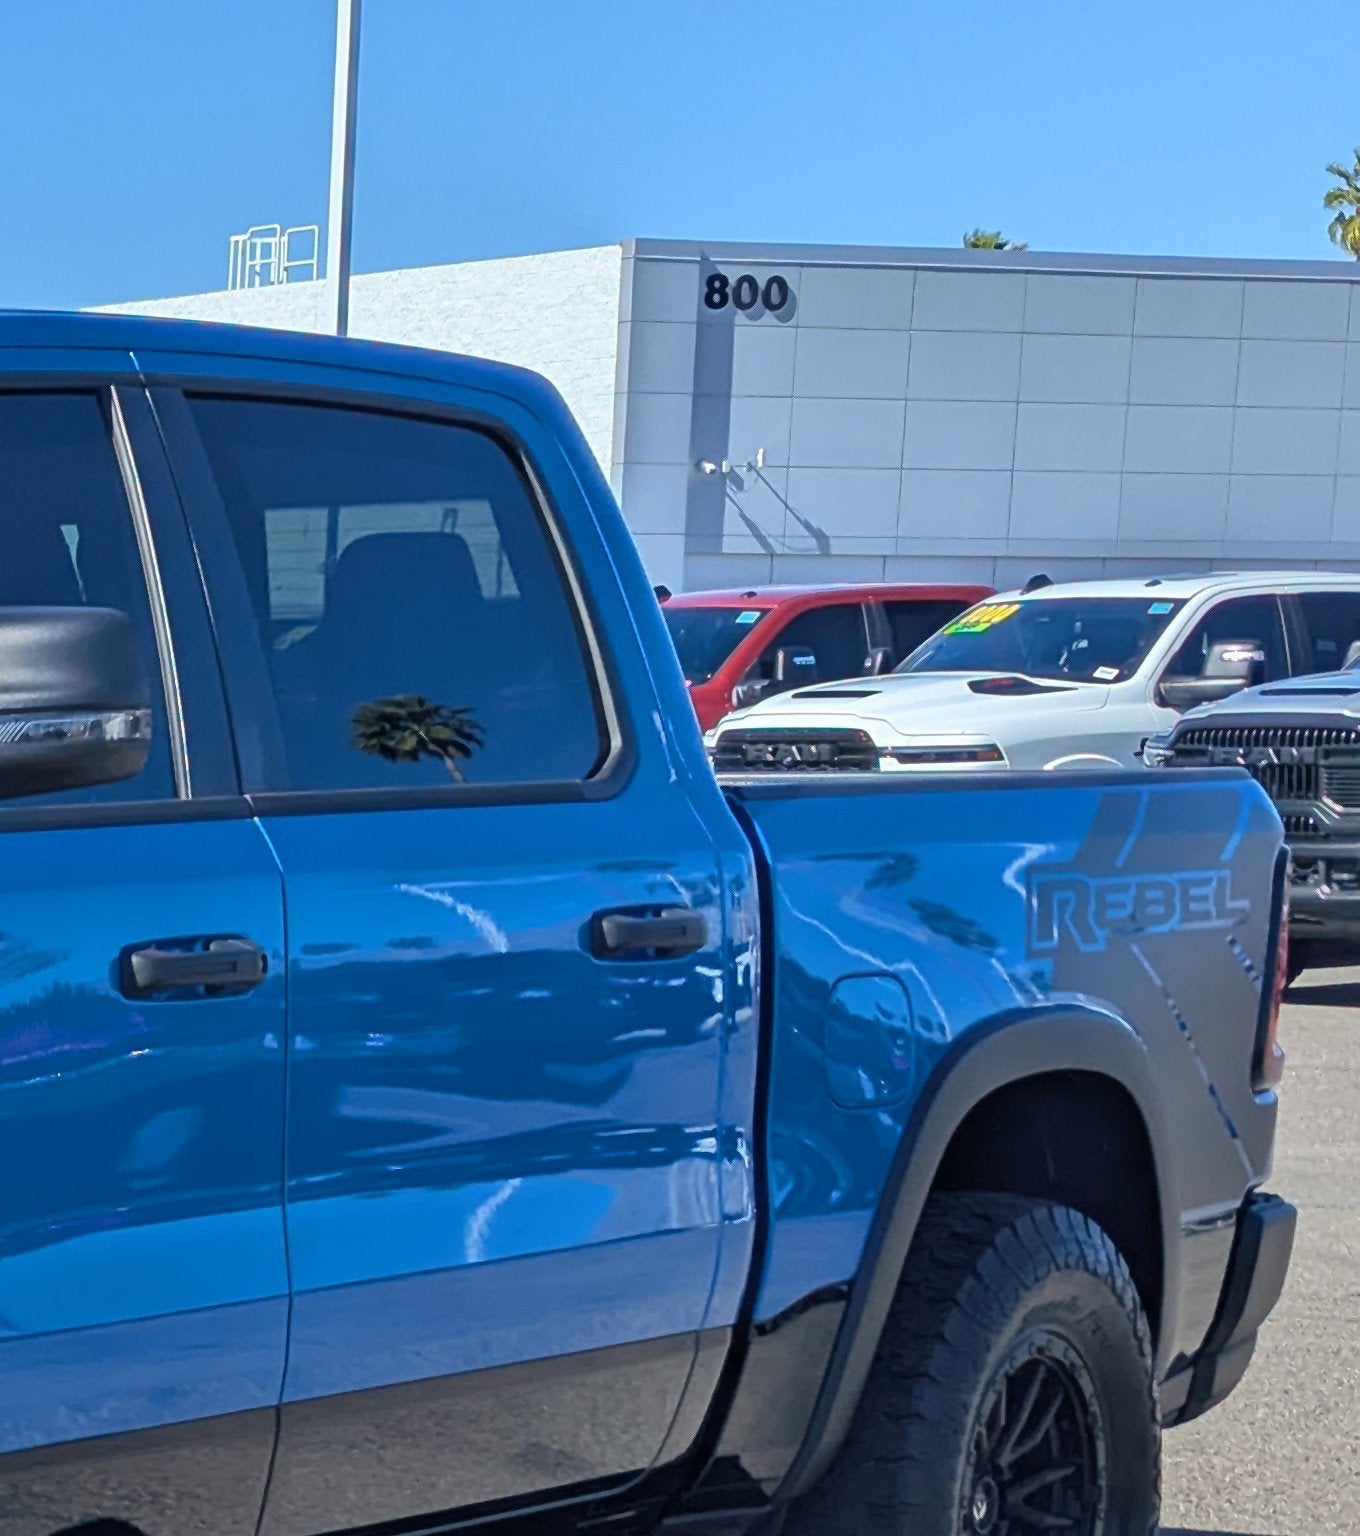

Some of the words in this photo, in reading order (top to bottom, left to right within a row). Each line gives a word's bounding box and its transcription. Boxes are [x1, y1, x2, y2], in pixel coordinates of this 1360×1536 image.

[704, 273, 789, 312] 800
[743, 743, 837, 762] RAM
[1031, 869, 1251, 952] REBEL
